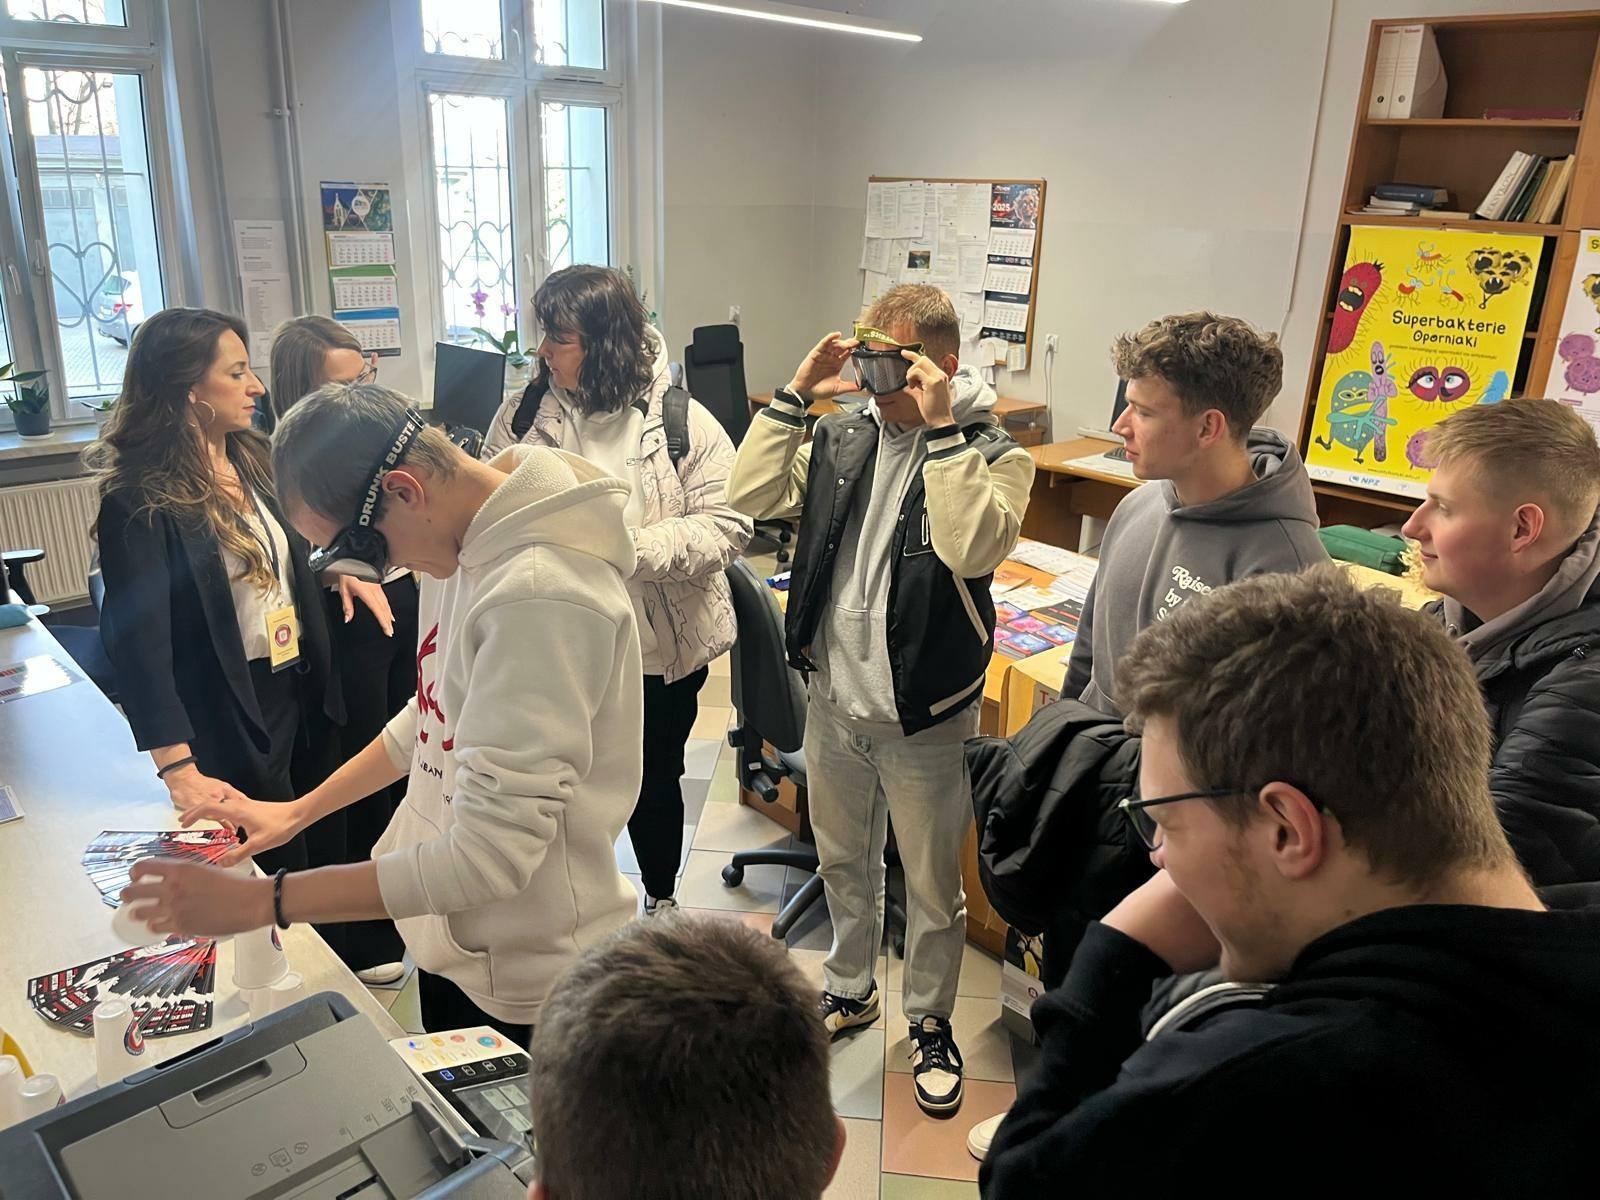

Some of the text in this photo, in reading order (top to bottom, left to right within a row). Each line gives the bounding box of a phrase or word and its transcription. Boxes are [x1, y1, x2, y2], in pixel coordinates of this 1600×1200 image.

[1392, 310, 1506, 335] Superbakterie
[1413, 329, 1478, 348] Oporniaki
[359, 422, 416, 527] DRUNK BUSTE
[1171, 565, 1215, 596] Raise
[1164, 588, 1183, 608] by
